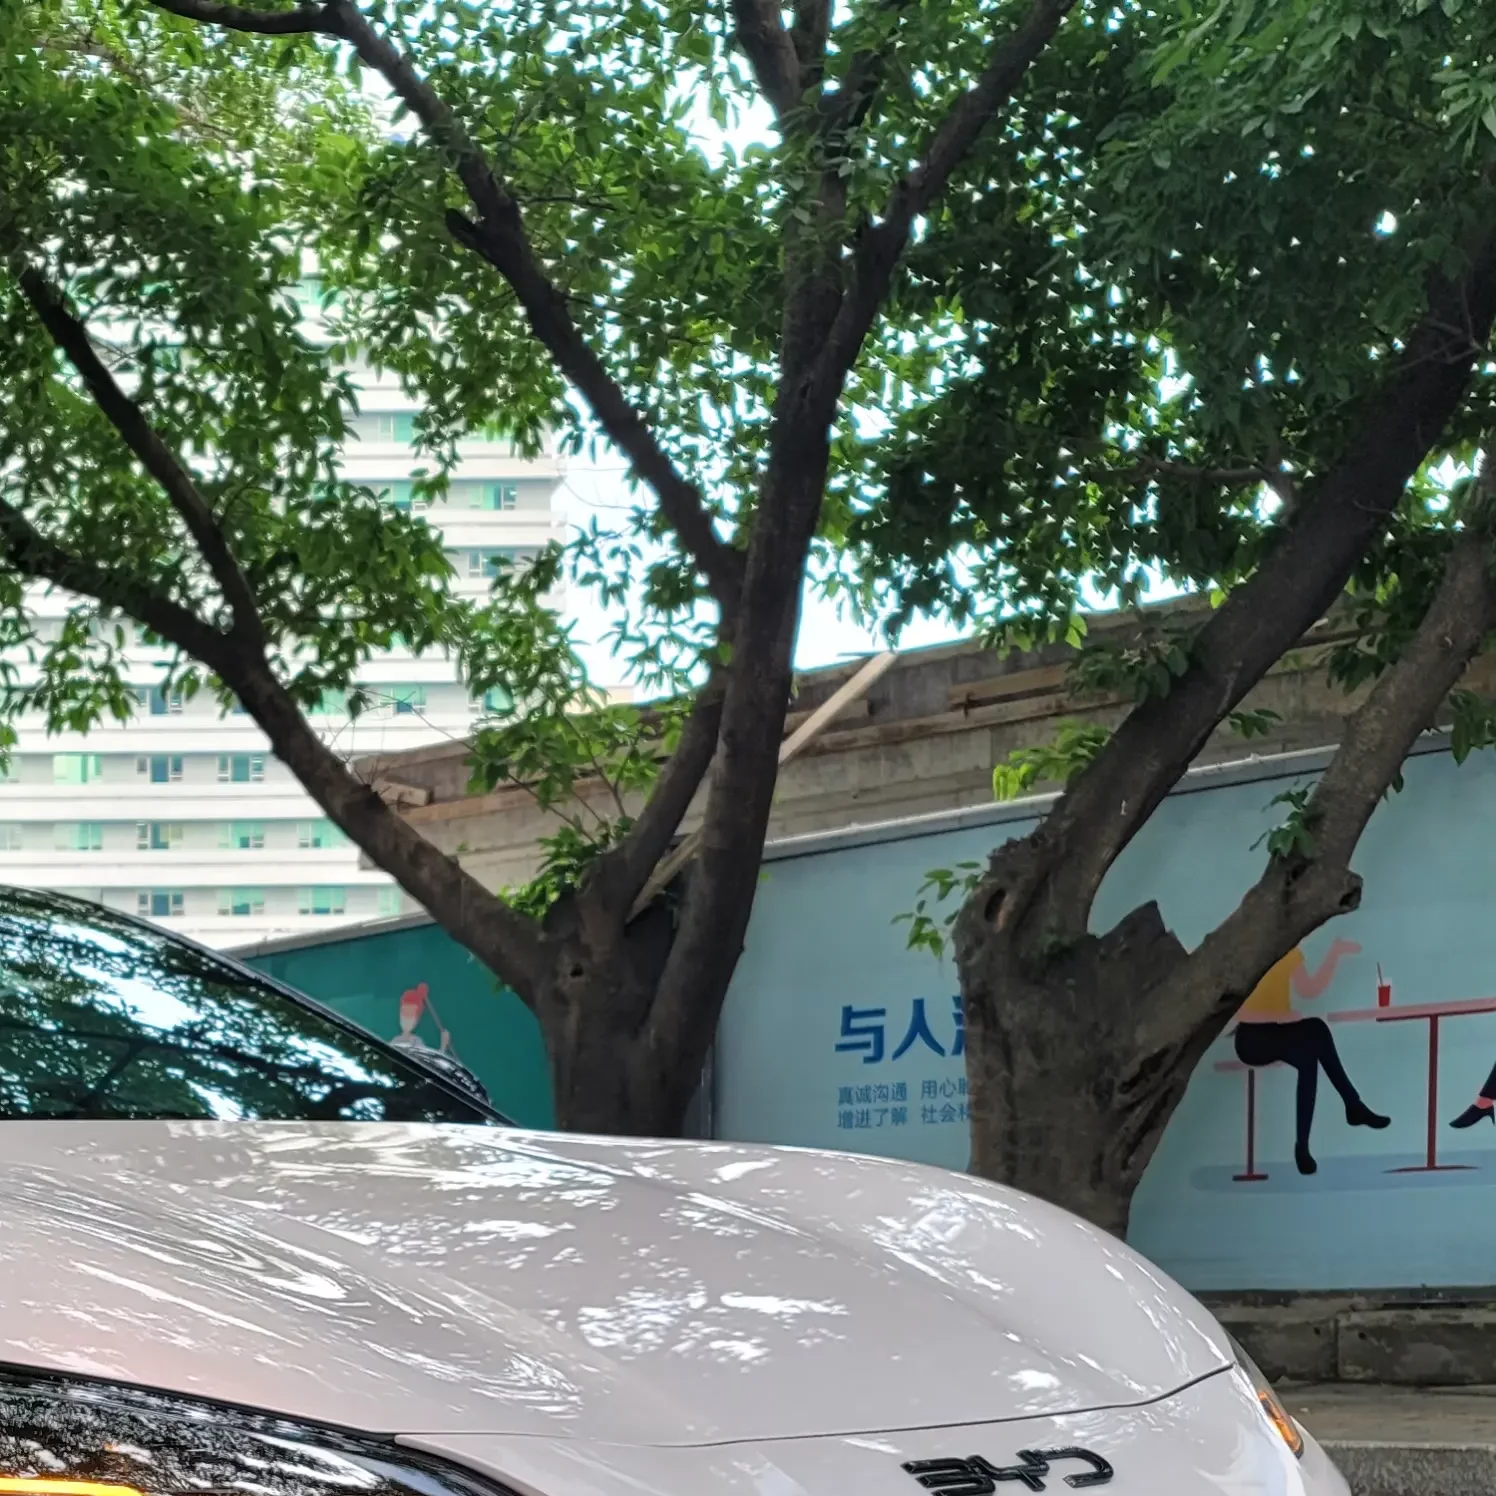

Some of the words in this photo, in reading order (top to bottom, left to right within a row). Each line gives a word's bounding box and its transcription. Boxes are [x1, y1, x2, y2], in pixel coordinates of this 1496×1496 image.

[837, 1081, 908, 1106] 真诚沟通
[837, 1106, 908, 1129] 增进了解
